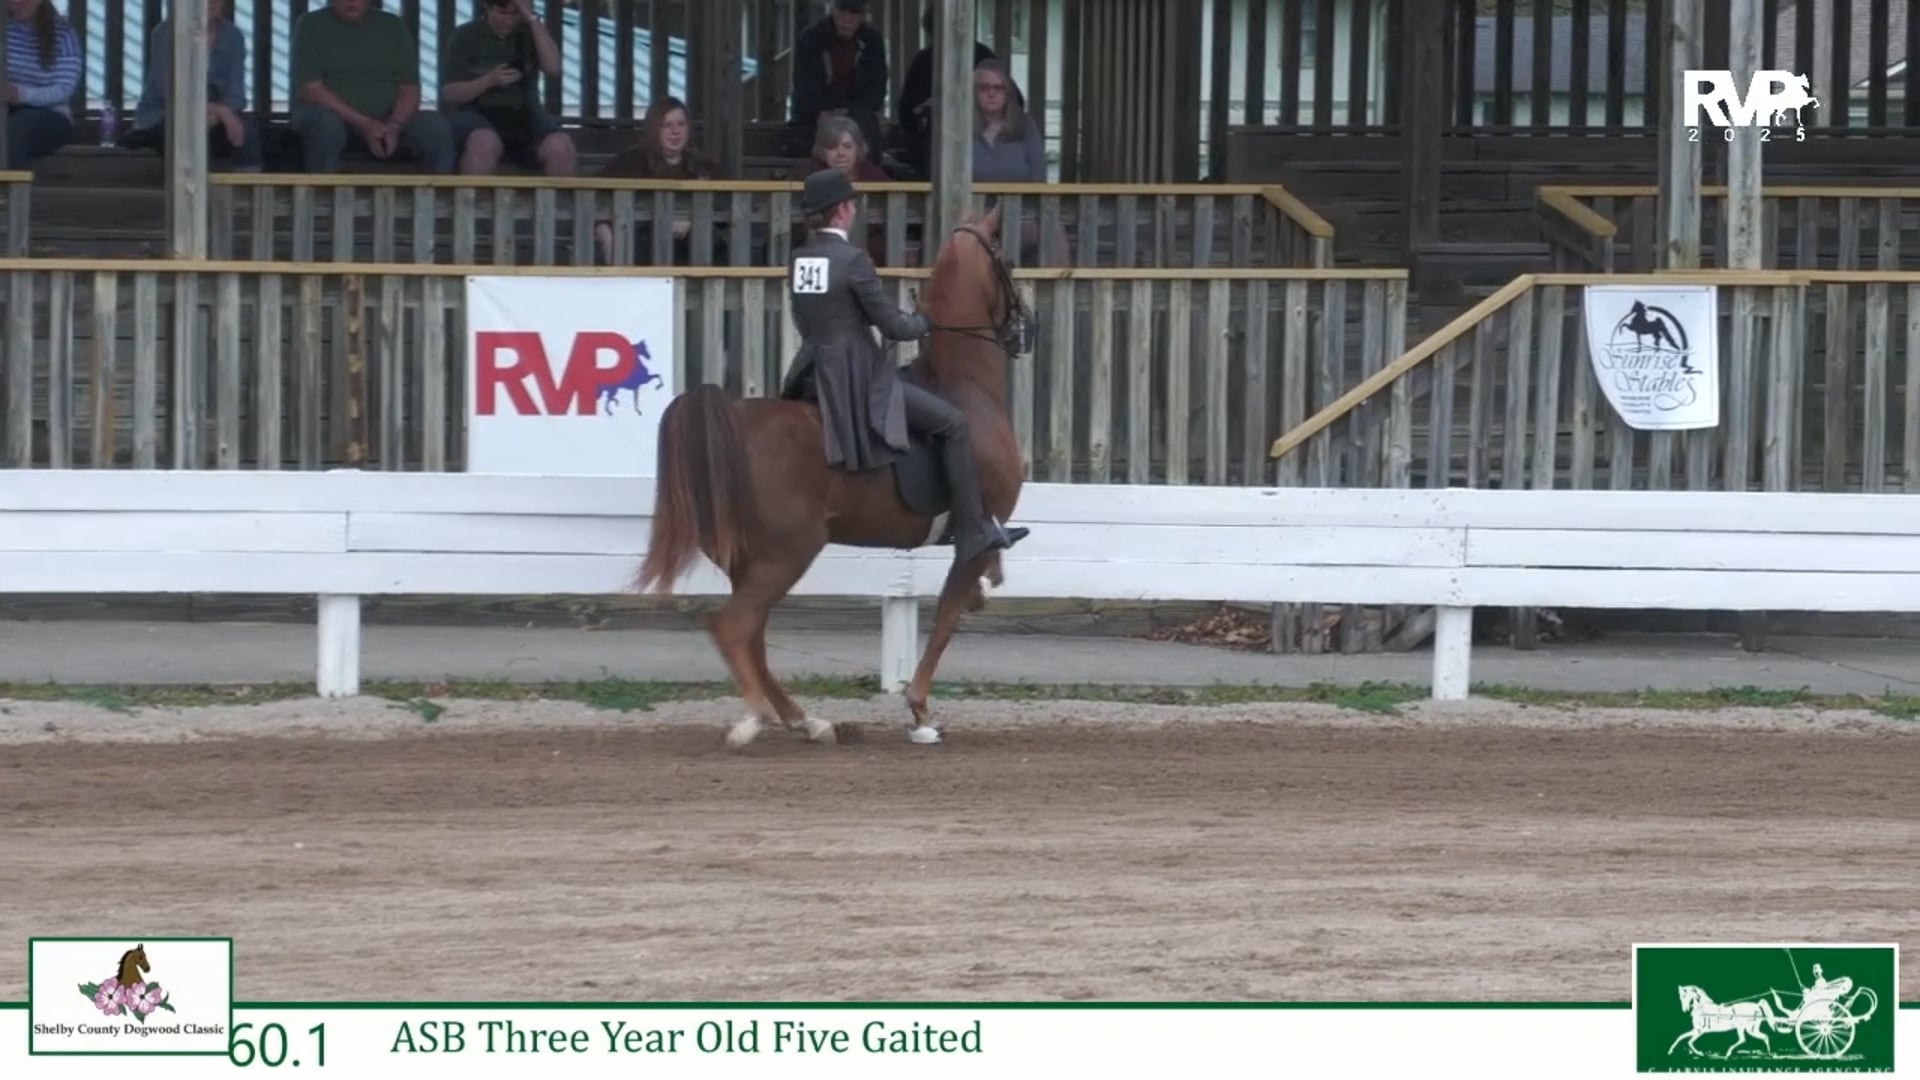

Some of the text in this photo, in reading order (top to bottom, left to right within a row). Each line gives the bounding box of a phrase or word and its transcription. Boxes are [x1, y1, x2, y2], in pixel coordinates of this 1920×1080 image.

[798, 265, 821, 291] 341
[475, 331, 636, 415] RVP
[1600, 347, 1680, 370] Sunrise
[1614, 371, 1697, 408] Stables
